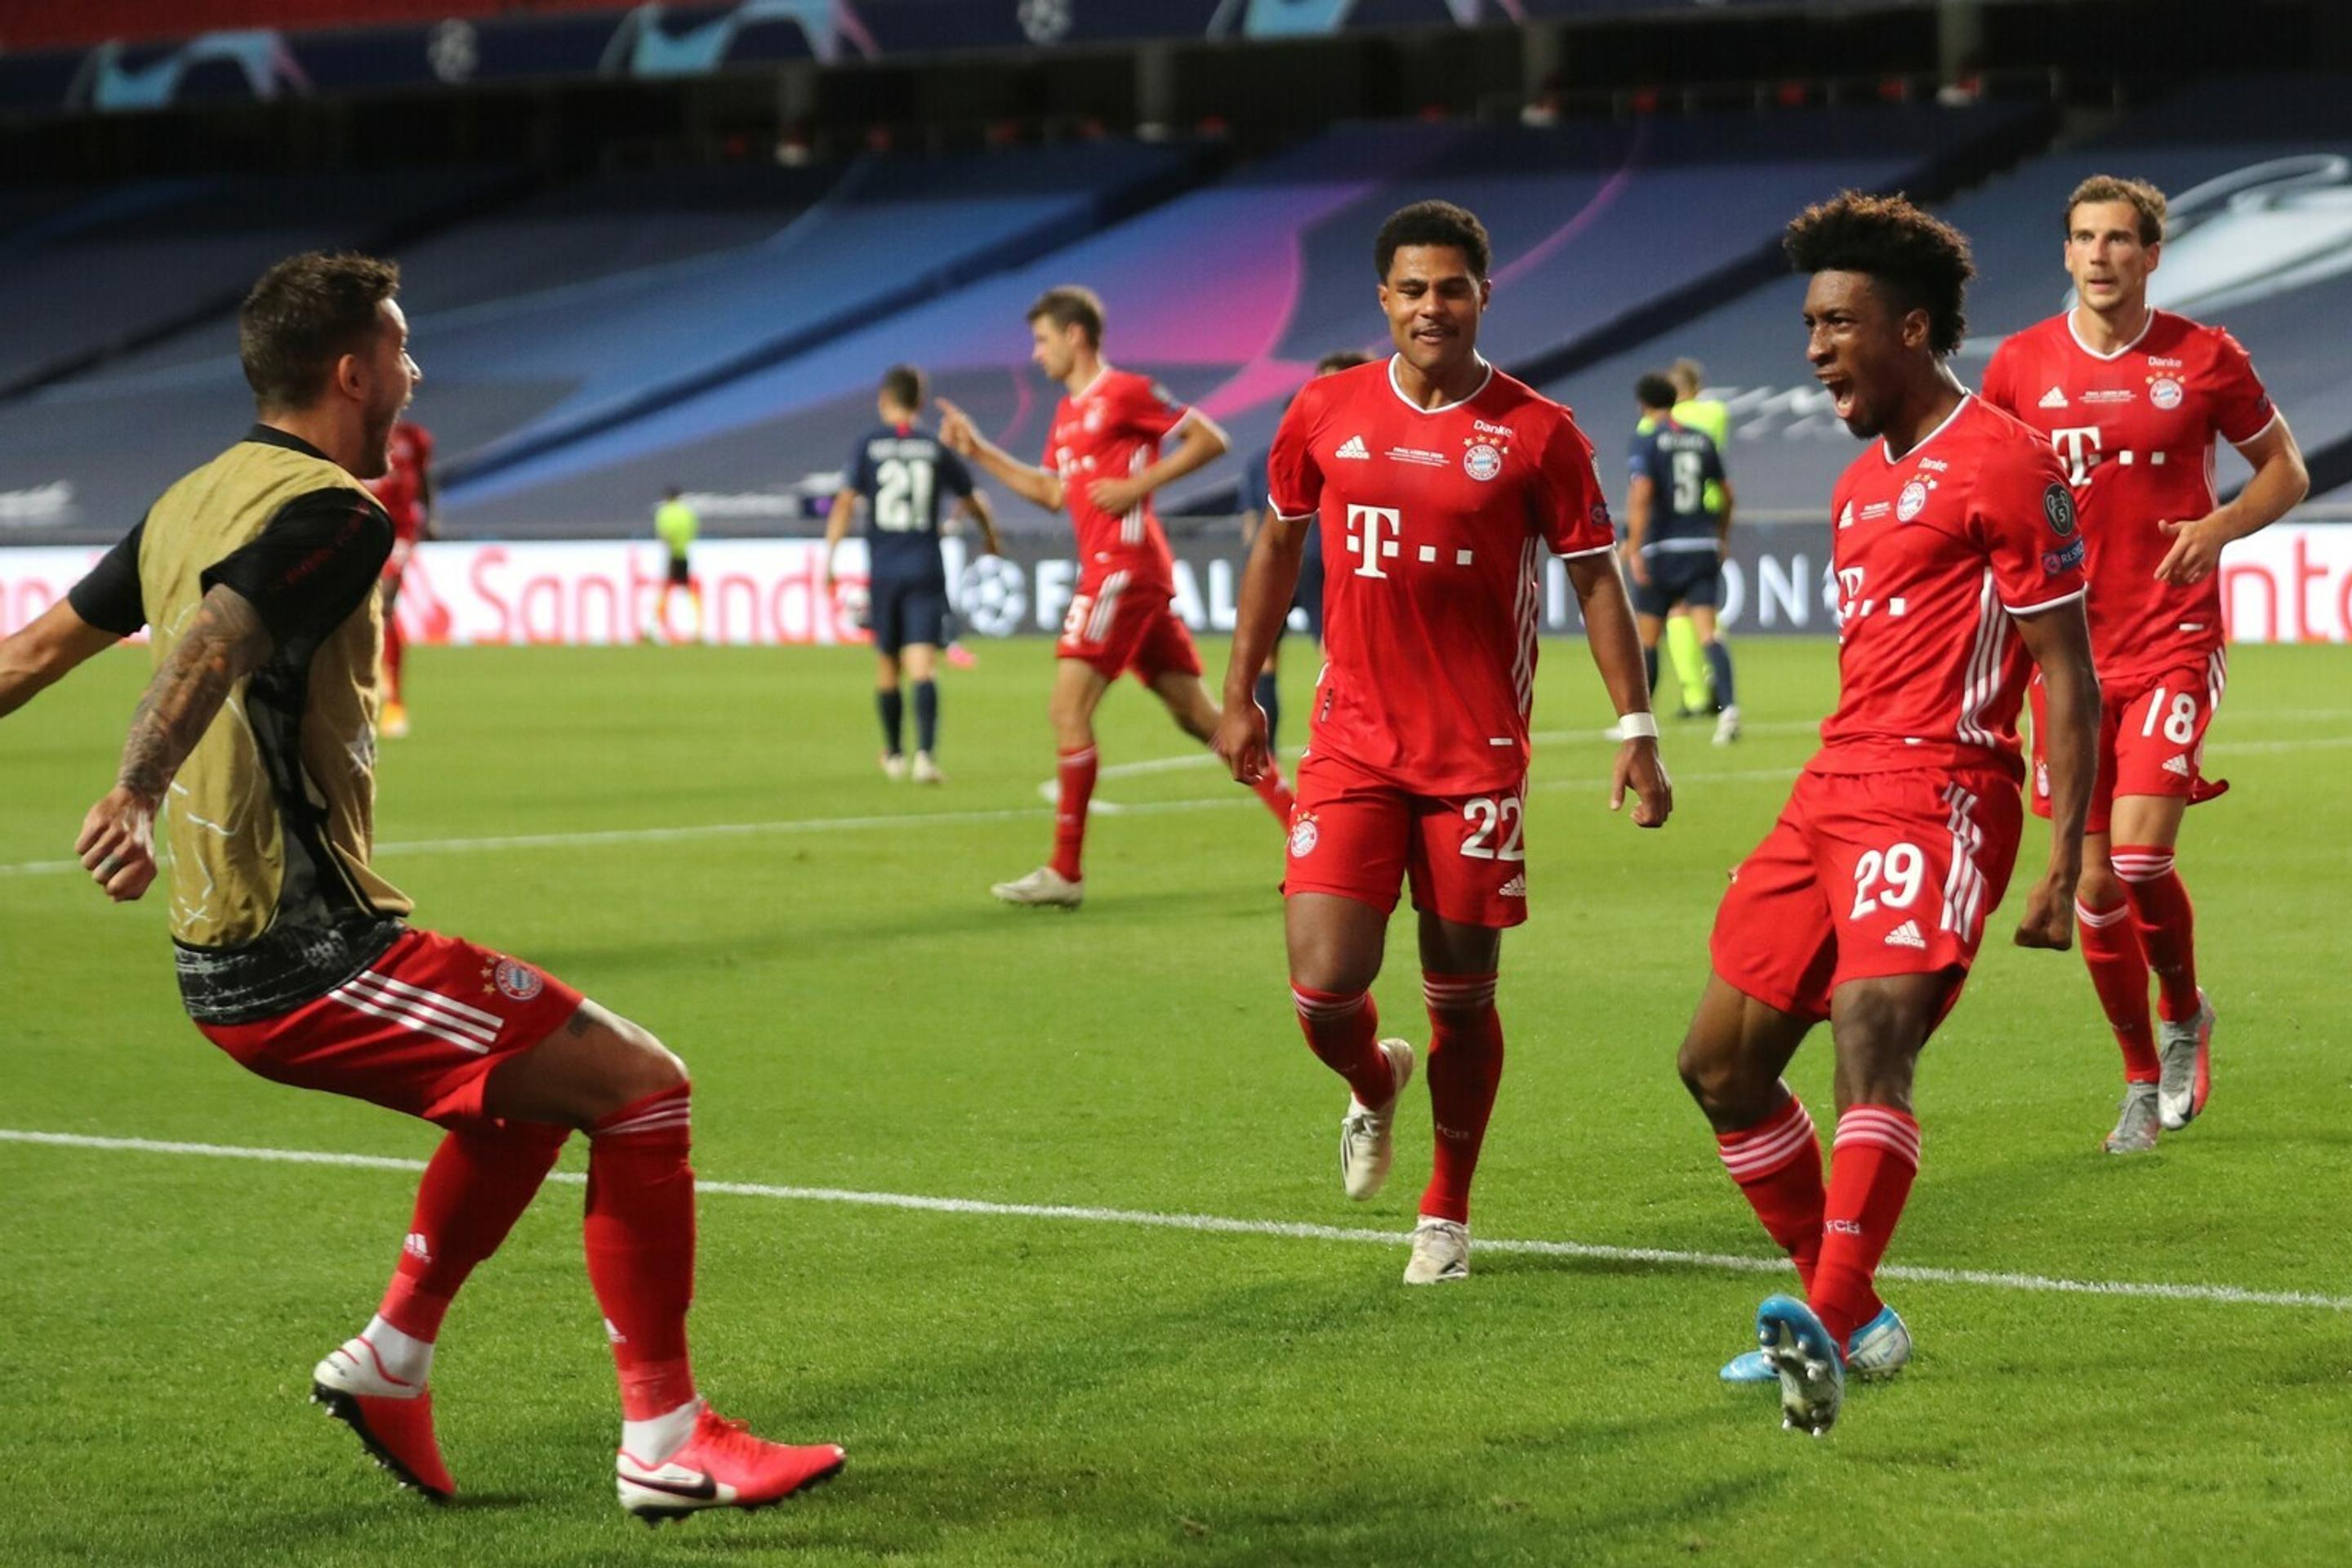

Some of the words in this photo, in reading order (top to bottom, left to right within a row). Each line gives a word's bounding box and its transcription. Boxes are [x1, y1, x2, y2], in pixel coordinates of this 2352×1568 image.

[2148, 355, 2182, 368] Danke
[1473, 419, 1512, 438] Danke
[875, 458, 932, 532] 21
[2058, 508, 2066, 522] 5
[2141, 687, 2197, 745] 18
[1459, 797, 1525, 862] 22
[1848, 842, 1924, 920] 29
